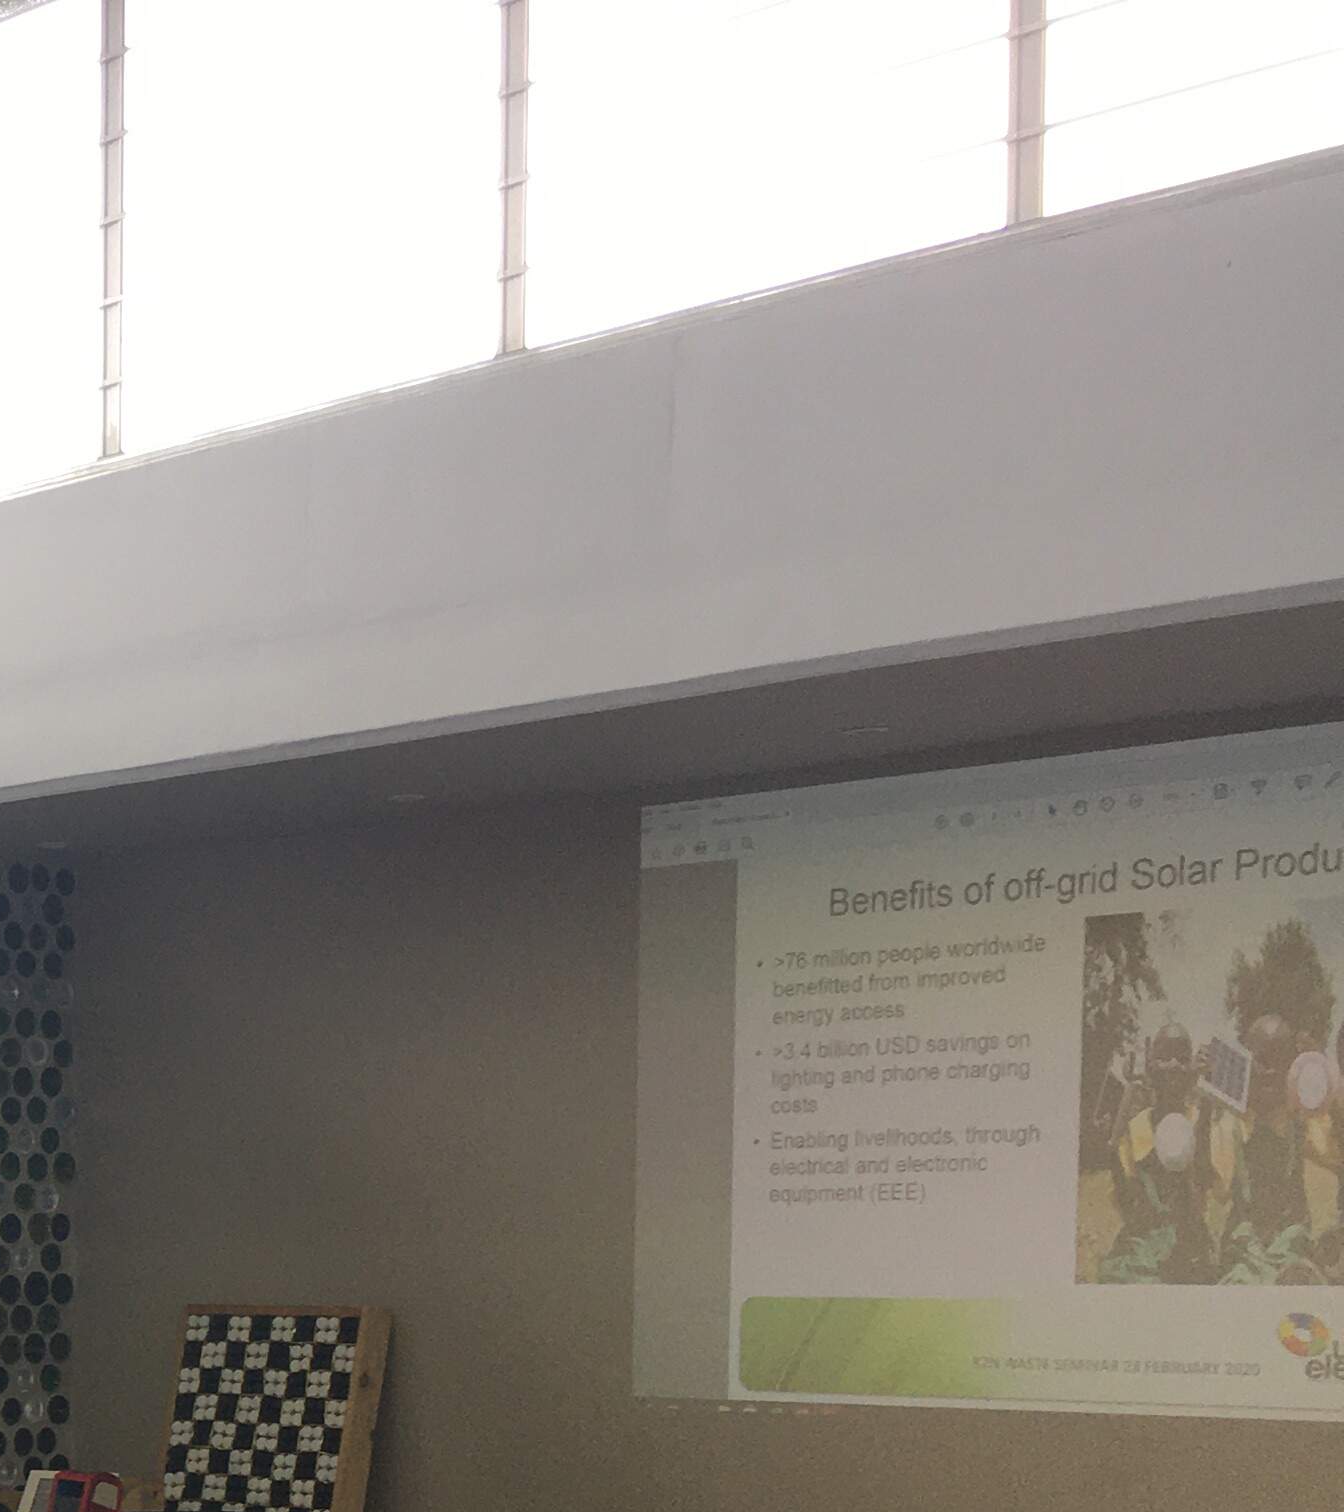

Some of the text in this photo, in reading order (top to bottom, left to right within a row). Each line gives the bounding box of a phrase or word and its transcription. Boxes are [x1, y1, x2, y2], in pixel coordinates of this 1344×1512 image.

[829, 842, 1344, 917] Benefits of off-grid Solar Produ
[812, 947, 872, 968] million
[878, 943, 941, 967] people
[947, 933, 1047, 958] worldwide
[772, 965, 1007, 998] benefitted from improved
[771, 1002, 905, 1027] energy access
[816, 1039, 871, 1058] billion
[876, 1034, 921, 1056] USD
[925, 1034, 999, 1056] savings
[1007, 1033, 1031, 1050] on
[771, 1060, 1031, 1091] lighting and phone charging
[771, 1099, 819, 1114] costs
[770, 1130, 849, 1152] Enabling
[965, 1124, 1042, 1147] through
[769, 1155, 988, 1175] electrical and electronic
[769, 1181, 927, 1206] equipment (EEE)
